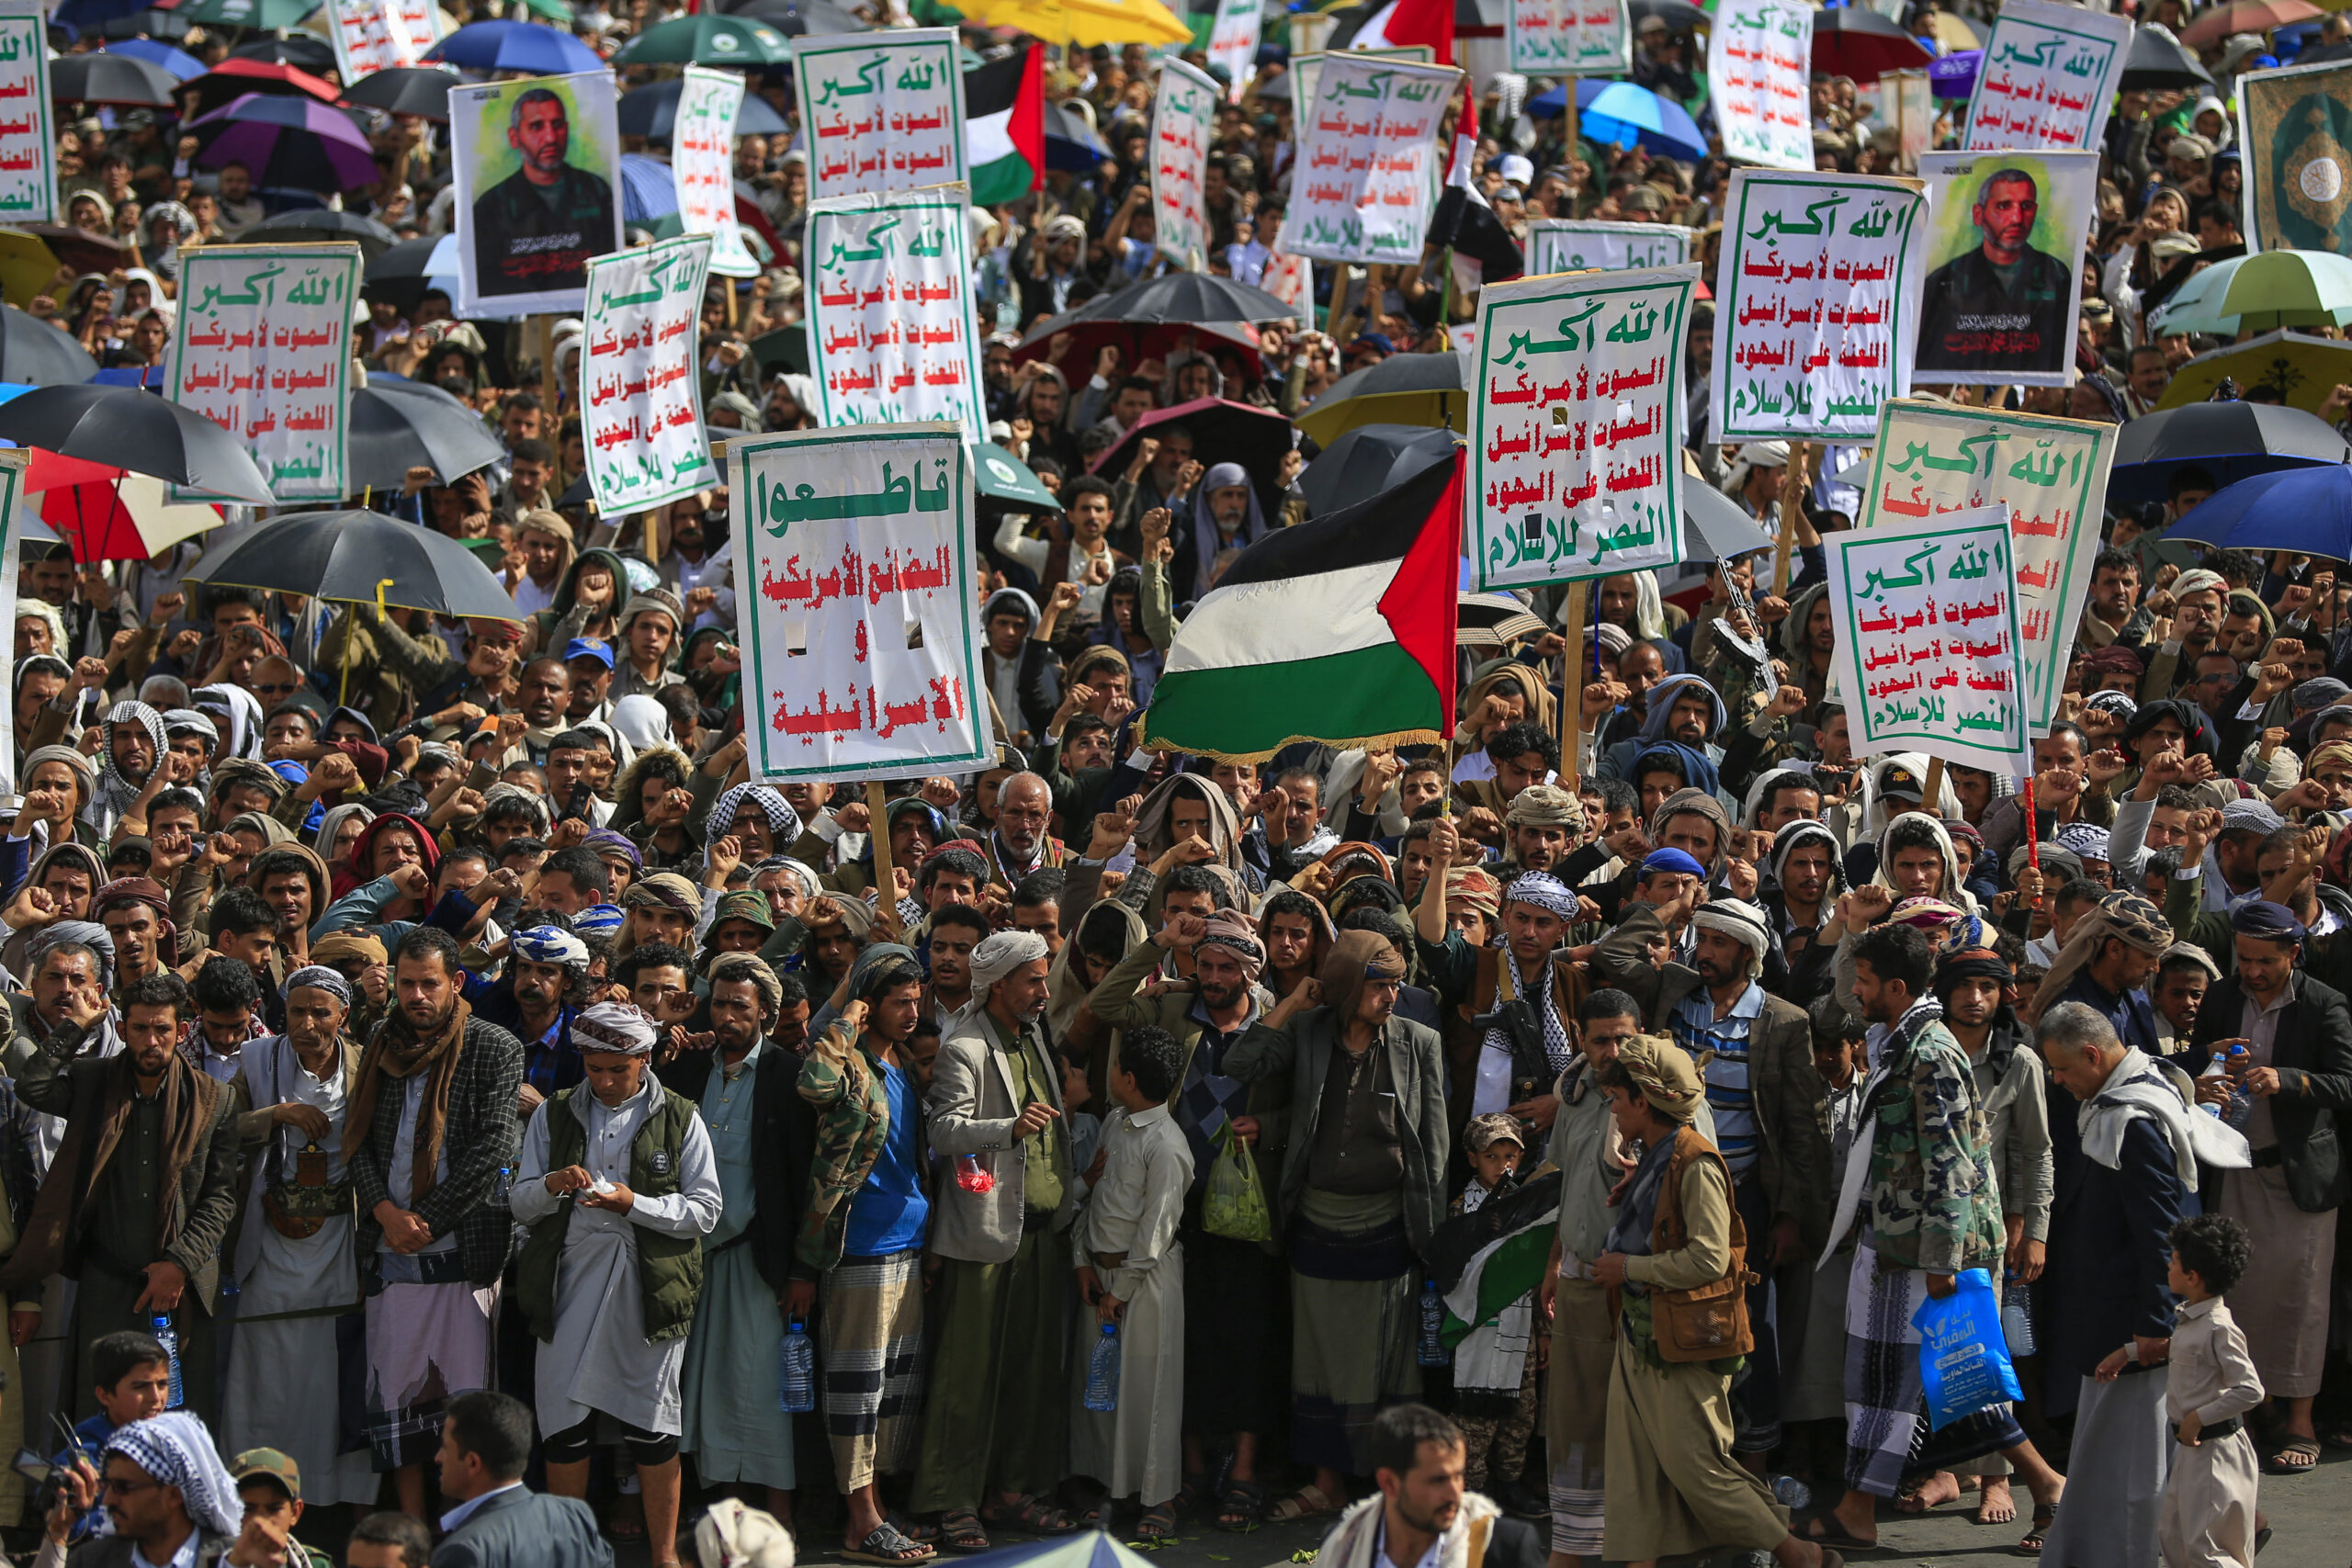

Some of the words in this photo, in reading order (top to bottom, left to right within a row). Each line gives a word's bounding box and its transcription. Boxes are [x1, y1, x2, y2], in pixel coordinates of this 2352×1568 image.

[1991, 33, 2066, 71] أكبر
[2064, 46, 2105, 80] الله
[814, 51, 890, 108] أكبر
[897, 55, 946, 90] الله
[1325, 70, 1395, 106] أكبر
[1984, 70, 2046, 101] لأمريكا
[1396, 83, 1442, 103] الله
[2047, 88, 2093, 113] الموت
[816, 104, 884, 140] لأمريكا
[891, 105, 947, 136] الموت
[1384, 118, 1428, 141] الموت
[2040, 120, 2083, 145] الموت
[820, 147, 886, 181] لإسرائيل
[893, 144, 951, 175] الموت
[1746, 190, 1850, 247] أكبر
[1849, 198, 1907, 238] الله
[820, 213, 901, 276] أكبر
[908, 219, 956, 257] الله
[673, 256, 703, 293] الله
[1744, 247, 1828, 284] لأمريكا
[1834, 254, 1894, 287] الموت
[189, 262, 285, 317] أكبر
[287, 268, 343, 304] الله
[594, 251, 678, 324] أكبر
[820, 270, 896, 310] لأمريكا
[901, 275, 957, 306] الموت
[1606, 299, 1674, 343] الله
[1738, 292, 1824, 331] لإسرائيل
[1827, 298, 1890, 331] الموت
[188, 318, 268, 352] لأمريكا
[274, 321, 338, 352] الموت
[591, 317, 652, 357] لأمريكا
[825, 320, 899, 354] لإسرائيل
[906, 319, 961, 349] الموت
[1491, 298, 1606, 370] أكبر
[923, 359, 966, 385] اللعنة
[1736, 340, 1794, 372] اليهود
[1801, 342, 1830, 374] على
[1838, 341, 1887, 367] اللعنة
[184, 360, 265, 398] لإسرائيل
[272, 362, 334, 394] الموت
[591, 365, 655, 407] لإسرائيل
[830, 363, 882, 395] اليهود
[889, 363, 915, 394] على
[1490, 363, 1589, 410] لأمريكا
[1596, 355, 1665, 400] الموت
[285, 403, 333, 431] اللعنة
[1734, 378, 1814, 428] للإسلام
[1818, 378, 1886, 426] النصر
[246, 408, 275, 438] على
[594, 415, 639, 452] اليهود
[1487, 420, 1586, 463] لإسرائيل
[1593, 402, 1661, 450] الموت
[1887, 425, 2011, 481] أكبر
[2008, 438, 2083, 488] الله
[1563, 471, 1597, 508] على
[1606, 452, 1661, 492] اللعنة
[757, 458, 949, 537] قاطعوا
[1487, 469, 1554, 513] اليهود
[1490, 516, 1579, 579] للإسلام
[1587, 500, 1666, 566] النصر
[763, 542, 864, 612] الأمريكية
[868, 543, 951, 606] البضائع
[1855, 540, 1942, 603] أكبر
[1948, 540, 2002, 581] الله
[1859, 595, 1937, 635] لأمريكا
[1943, 591, 2006, 627] الموت
[854, 619, 867, 663] و
[1864, 638, 1942, 671] لإسرائيل
[1948, 630, 2008, 660] الموت
[1868, 671, 1921, 700] اليهود
[1929, 667, 1958, 690] على
[1966, 666, 2013, 693] اللعنة
[773, 674, 963, 746] الإسرائيلية
[1873, 695, 1944, 733] للإسلام
[1952, 697, 2014, 735] النصر
